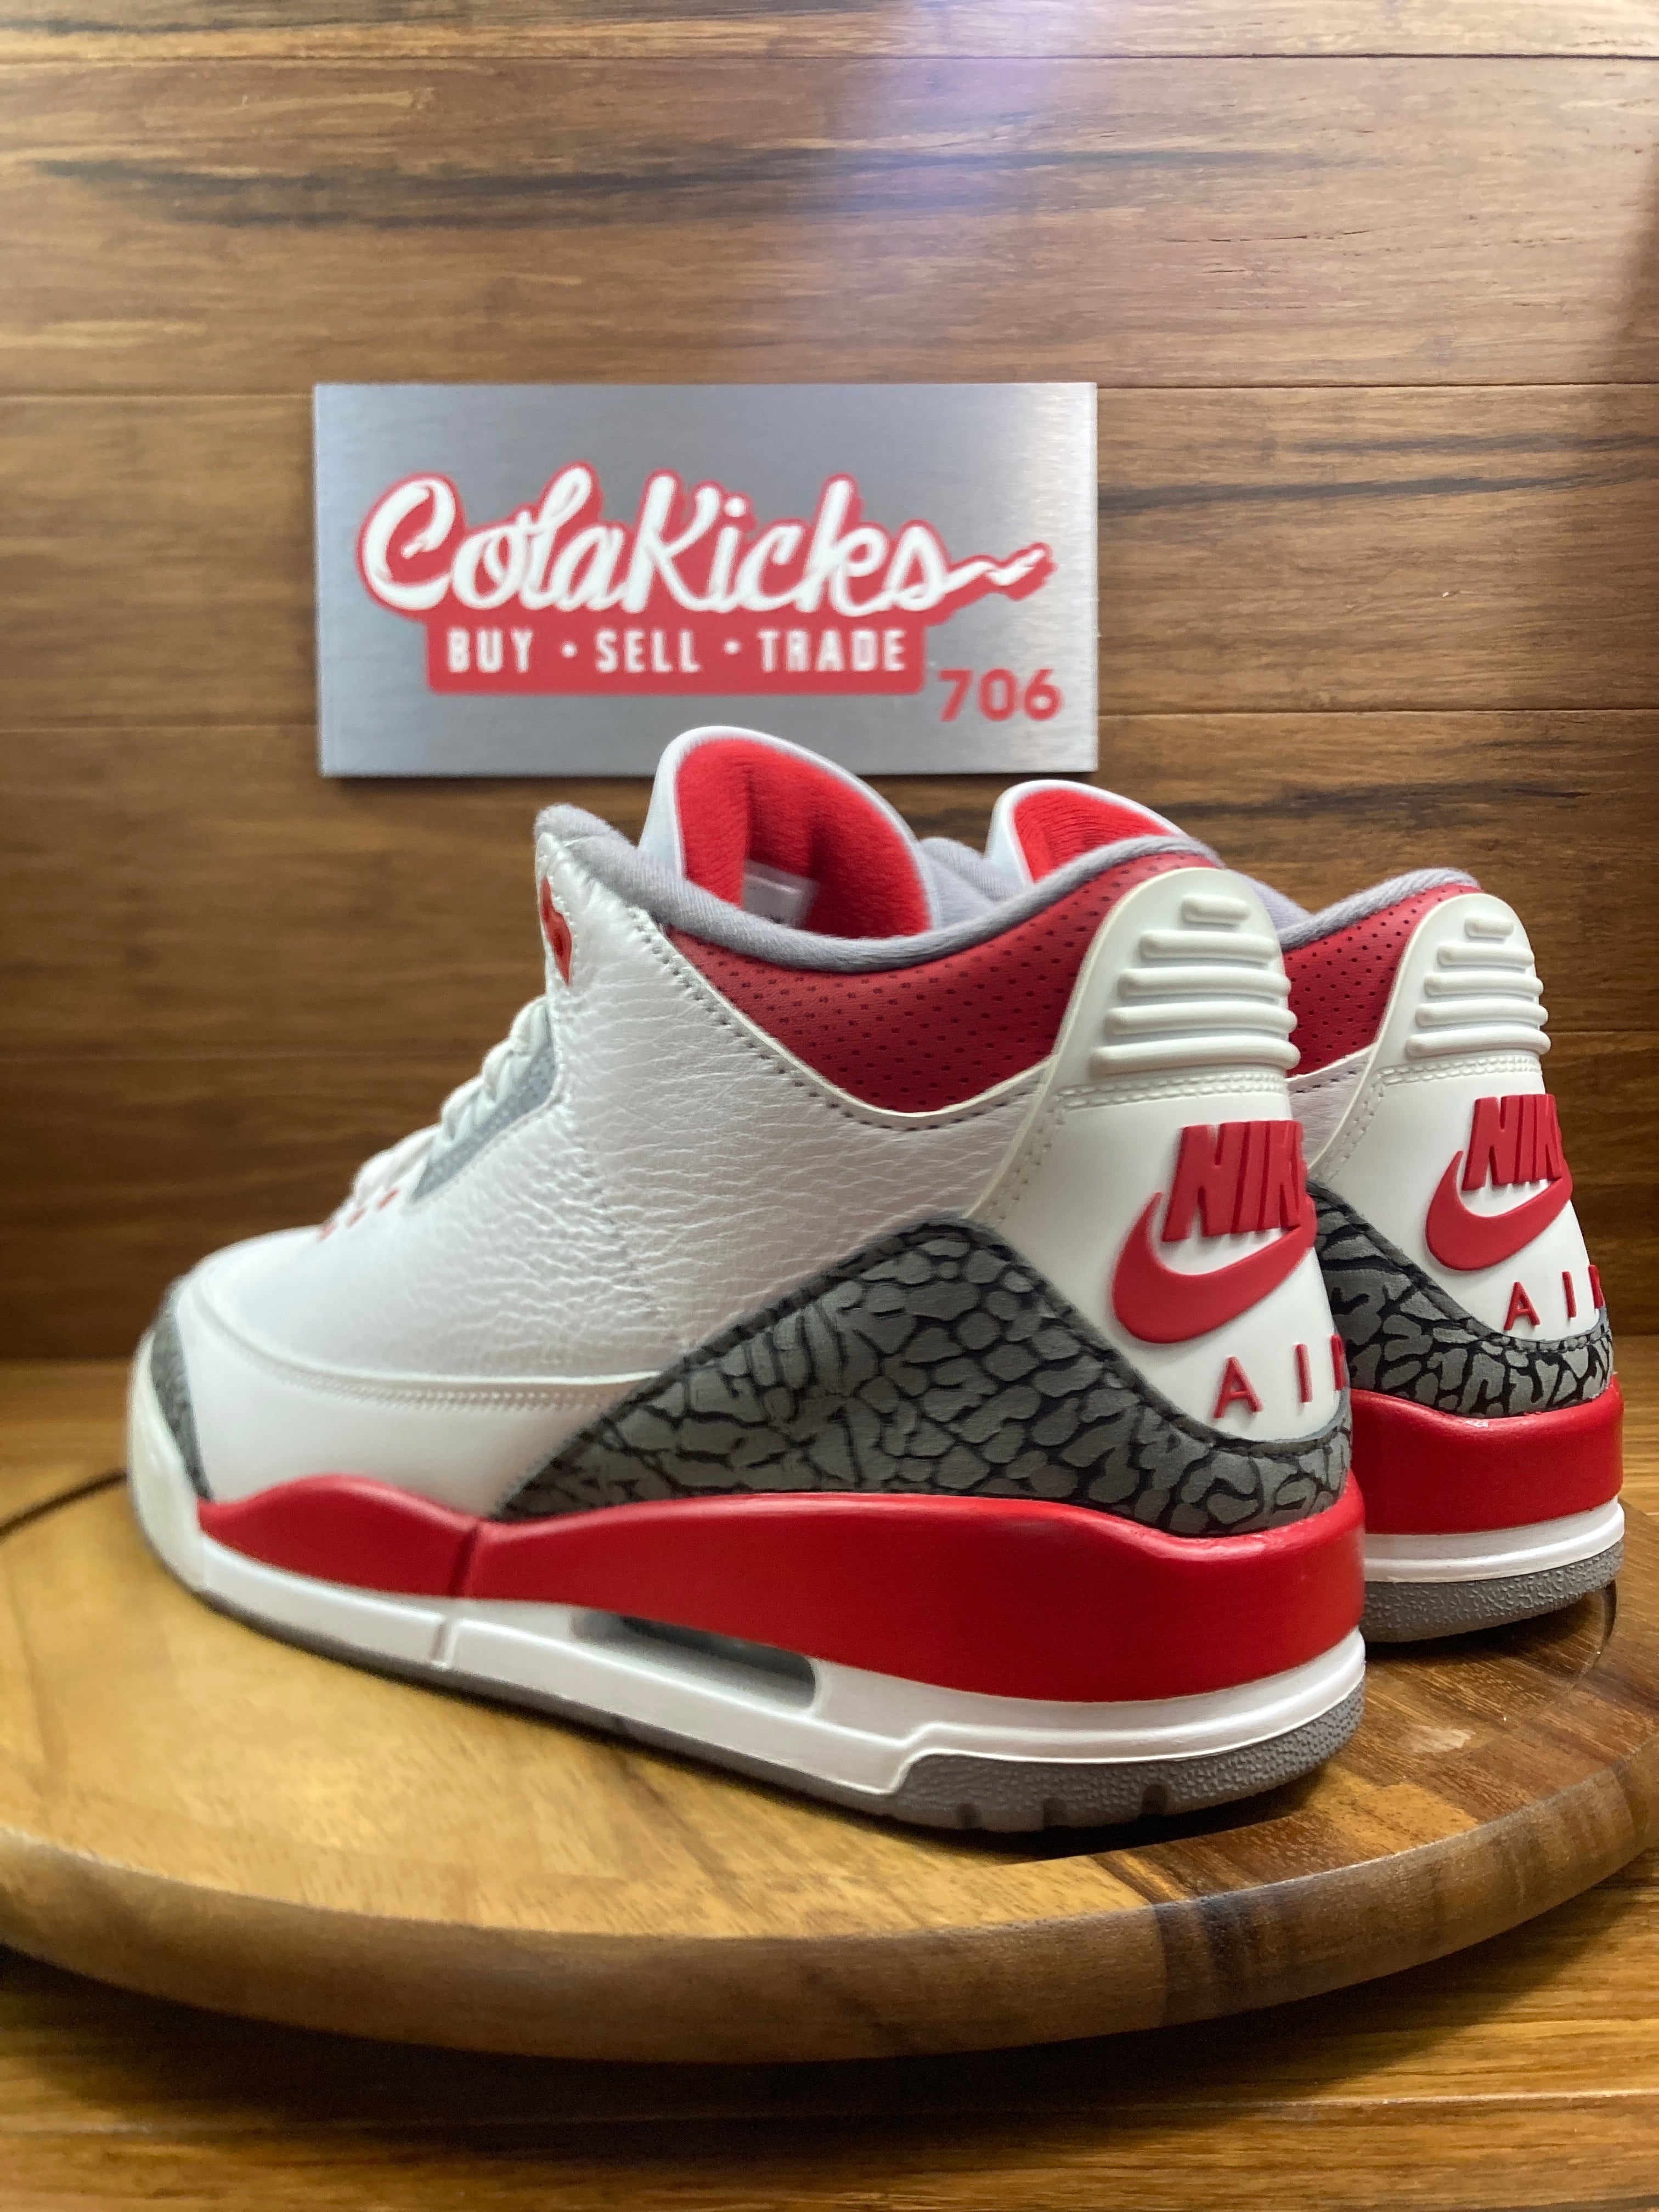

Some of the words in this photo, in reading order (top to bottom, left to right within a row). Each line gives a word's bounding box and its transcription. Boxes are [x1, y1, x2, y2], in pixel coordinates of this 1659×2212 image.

[447, 628, 534, 673] BUY
[595, 628, 701, 673] SELL
[759, 628, 907, 673] TRADE
[939, 670, 1062, 722] 706
[1462, 1094, 1562, 1190] NIK
[1162, 1120, 1308, 1242] NIK
